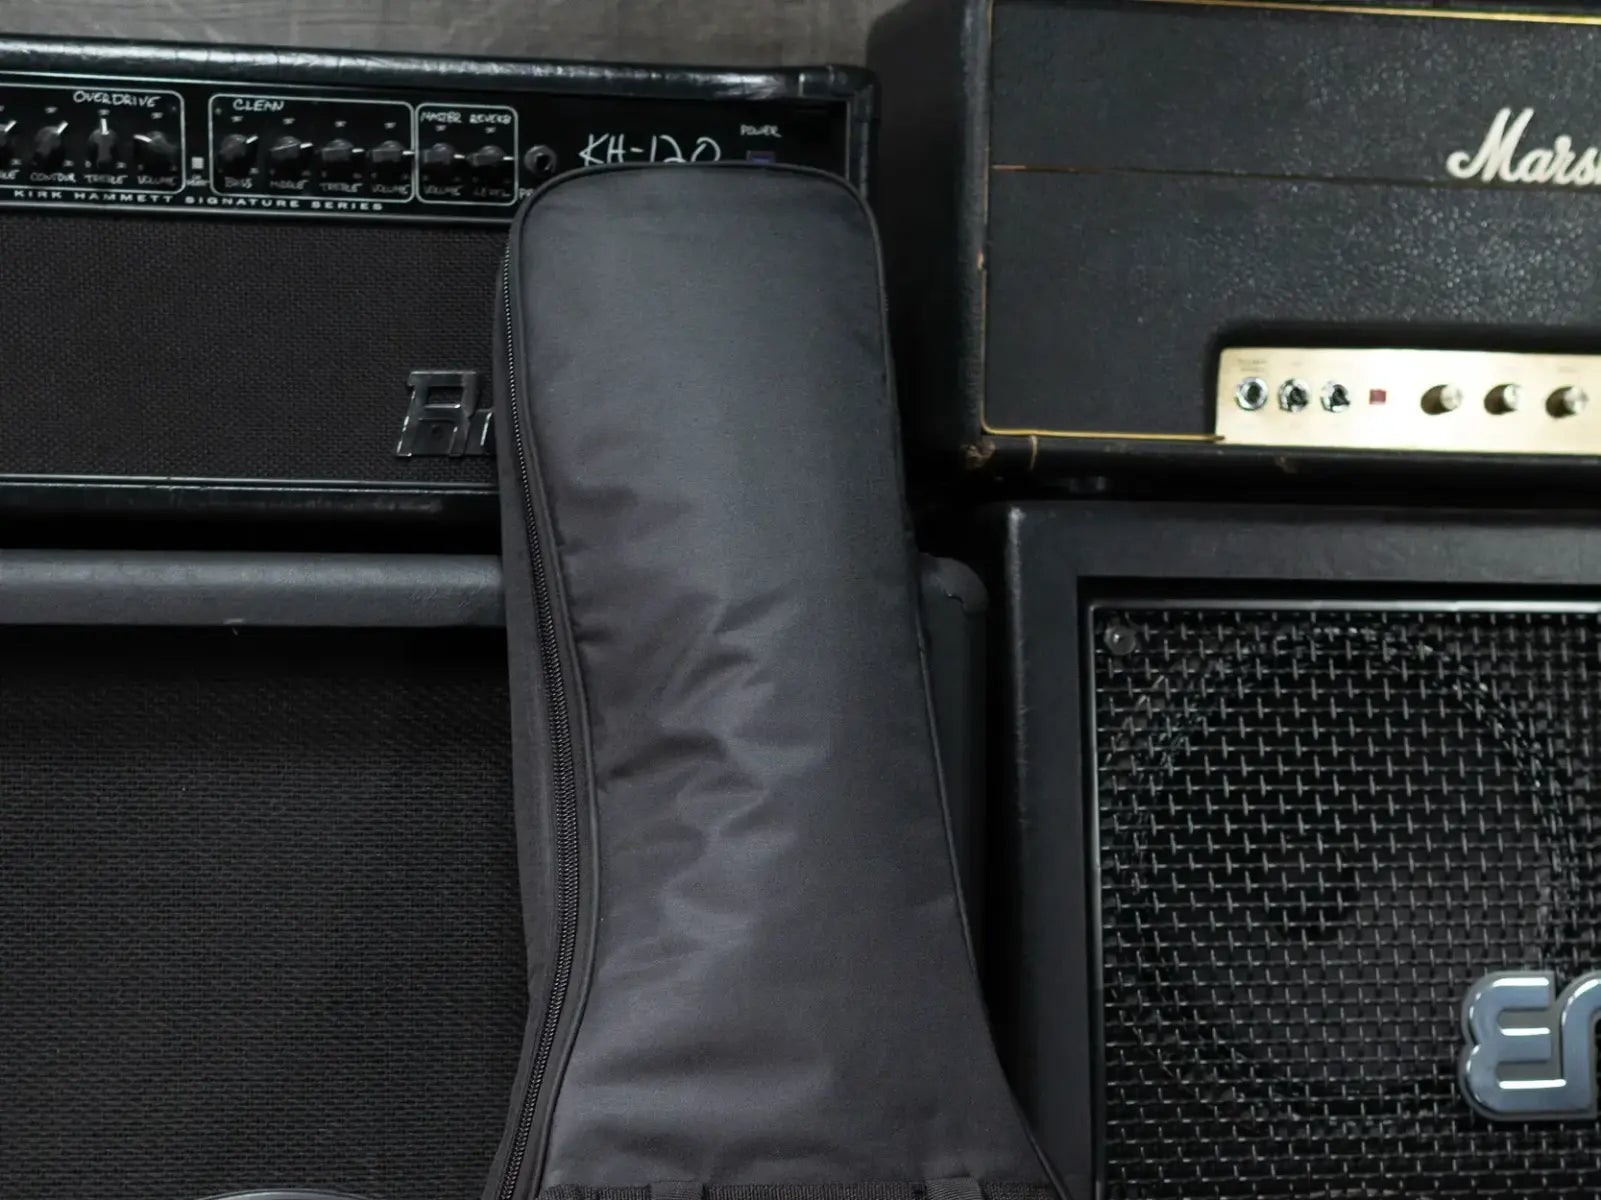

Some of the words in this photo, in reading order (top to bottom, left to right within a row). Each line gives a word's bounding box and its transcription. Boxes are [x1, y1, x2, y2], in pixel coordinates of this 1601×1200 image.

[72, 90, 162, 108] OVERDRIVE
[232, 98, 285, 112] CLEAN
[577, 132, 722, 166] KH-120
[1446, 107, 1601, 185] Mars
[13, 190, 63, 200] KIRK
[74, 193, 174, 204] HAMMETT
[185, 196, 300, 208] SIGNATURE
[310, 200, 383, 211] SERIES
